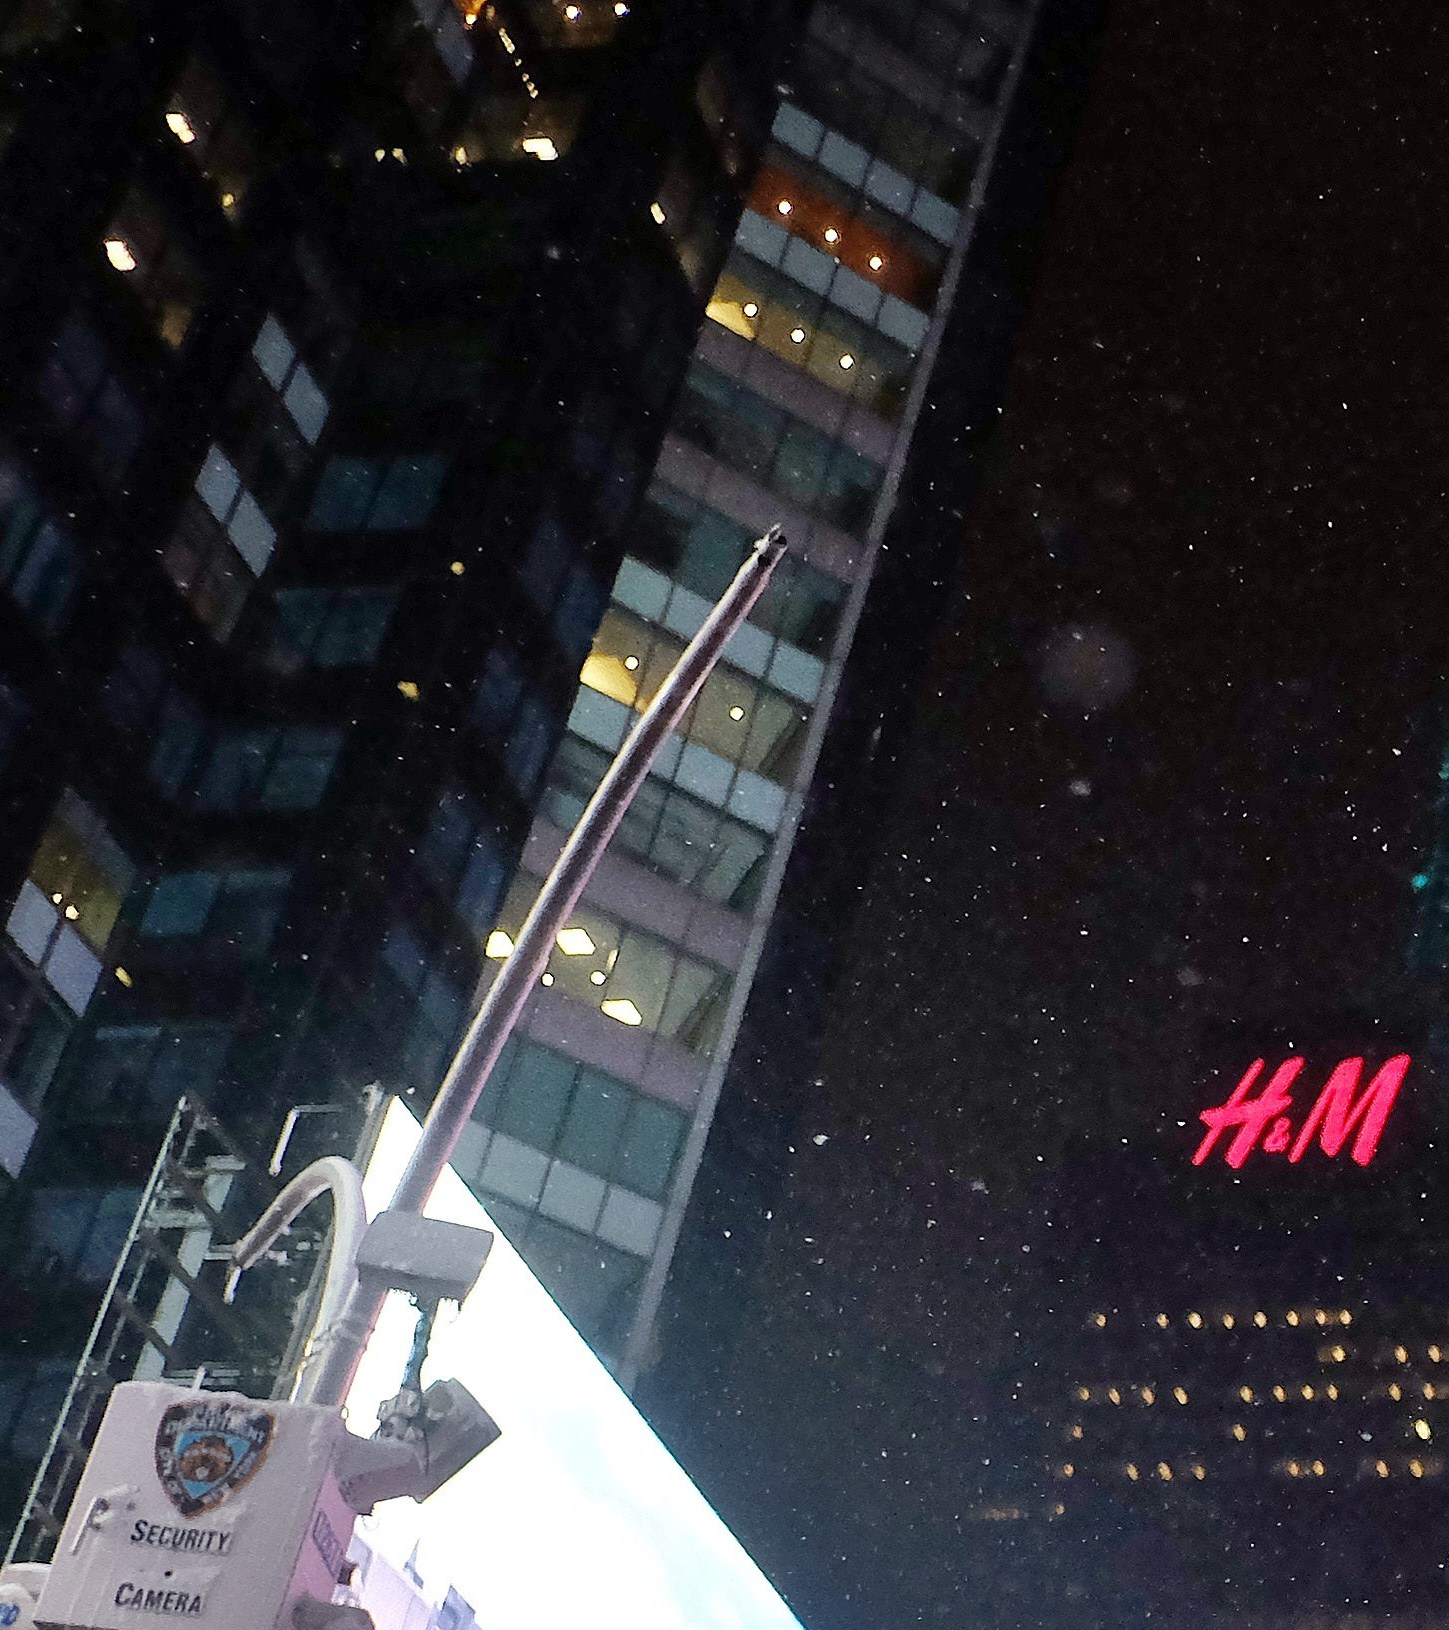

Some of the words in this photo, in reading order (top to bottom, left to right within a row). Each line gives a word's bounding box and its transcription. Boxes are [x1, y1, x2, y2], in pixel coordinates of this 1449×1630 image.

[1191, 1053, 1412, 1169] H&M
[130, 1519, 232, 1551] SECURITY
[114, 1582, 201, 1613] CAMERA
